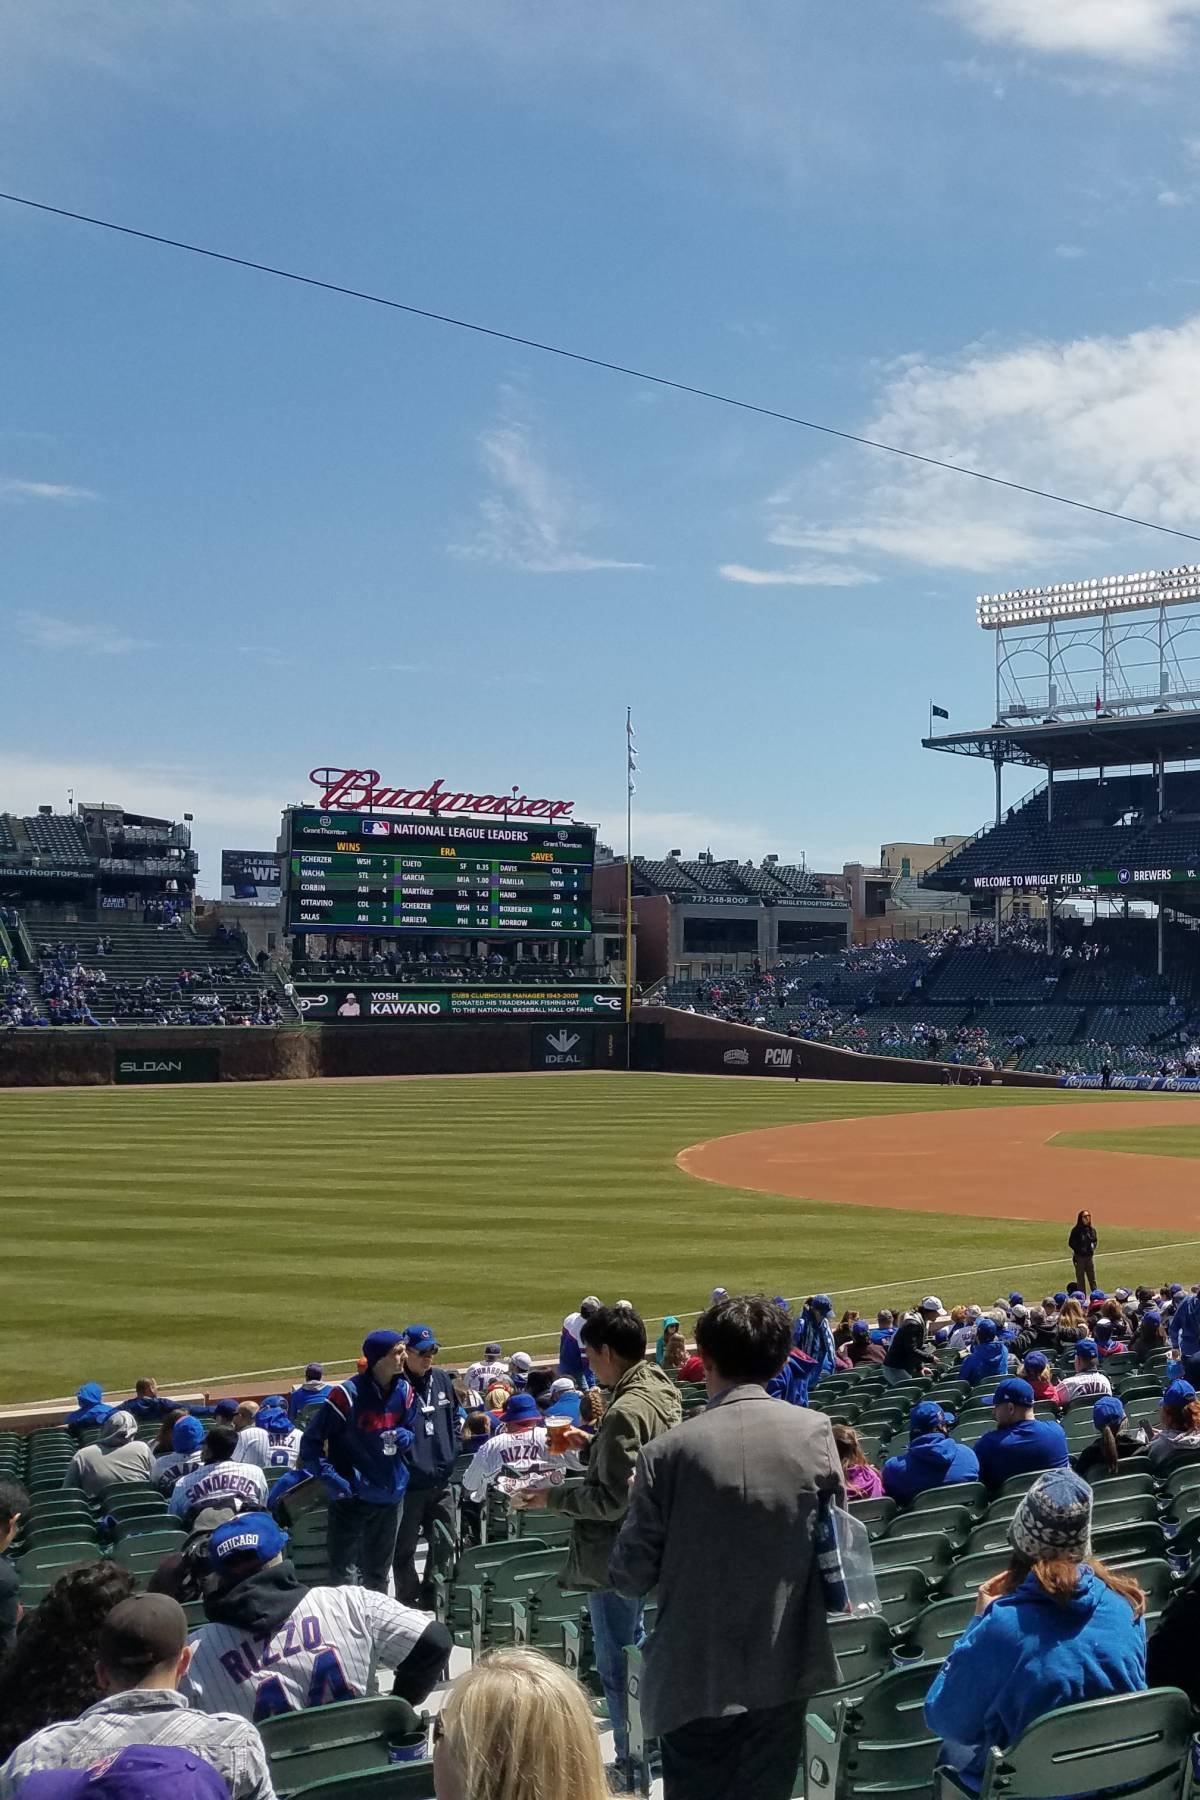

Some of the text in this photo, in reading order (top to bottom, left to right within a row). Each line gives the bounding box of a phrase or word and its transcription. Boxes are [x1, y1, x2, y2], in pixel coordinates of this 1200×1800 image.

[309, 767, 575, 819] Budweiser
[394, 823, 529, 842] NATIONAL LEAGUE LEADERS
[336, 842, 360, 852] WINS
[440, 848, 457, 857] ERA
[531, 853, 554, 862] SAVES
[301, 856, 332, 864] SCHERZER
[357, 858, 371, 866] WSH
[402, 860, 422, 868] CUETO
[301, 869, 325, 878] WACHA
[500, 865, 518, 873] DAVIS
[551, 867, 563, 875] COL
[1133, 869, 1172, 881] BREWERS
[402, 873, 425, 881] GARCIA
[974, 873, 1081, 888] WELCOME TO WRIGLEY FIELD
[499, 877, 525, 886] FAMILIA
[550, 880, 564, 888] NYM
[301, 884, 326, 892] CORBIN
[476, 890, 489, 898] 1.43
[499, 891, 517, 899] HAND
[300, 899, 334, 907] OTTAVINO
[692, 895, 749, 904] 773-248-ROOF
[401, 902, 431, 910] SCHERZER
[476, 904, 489, 912] 1.62
[300, 912, 320, 921] SALAS
[357, 914, 369, 922] ARI
[401, 916, 428, 924] ARRIETA
[476, 918, 489, 926] 1.82
[551, 920, 563, 928] CHC
[371, 992, 399, 1001] YOSH
[370, 1003, 441, 1014] KAWANO
[545, 1054, 581, 1064] IDEAL
[764, 1048, 793, 1064] PCM
[120, 1061, 182, 1072] SLOAN
[1110, 1076, 1139, 1089] Wrap
[500, 1444, 539, 1463] RIZZO
[186, 1473, 260, 1503] SANDBERG
[217, 1533, 259, 1557] CHICAGO
[220, 1616, 322, 1684] RIZZO
